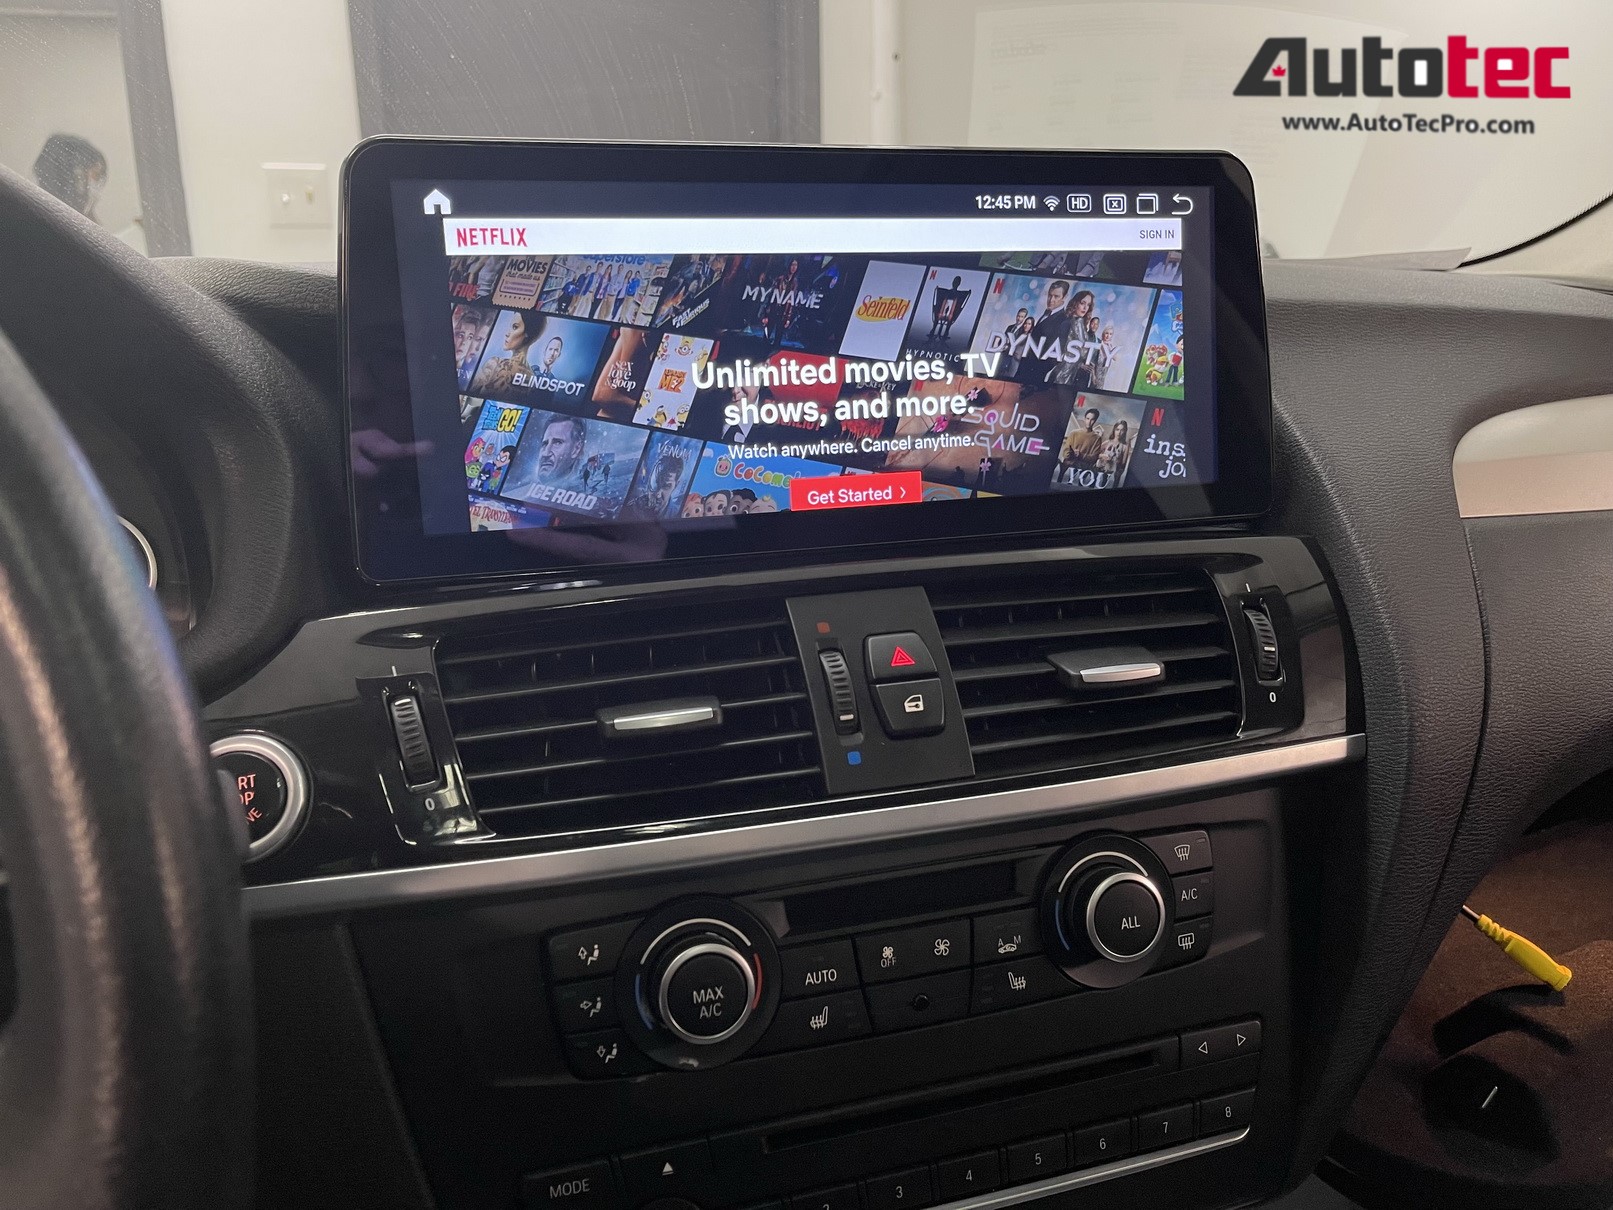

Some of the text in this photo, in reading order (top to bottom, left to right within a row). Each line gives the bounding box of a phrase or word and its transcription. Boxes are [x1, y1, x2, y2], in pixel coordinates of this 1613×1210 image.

[975, 195, 1035, 209] 12:45 PM
[1071, 197, 1088, 209] HD
[456, 227, 527, 247] NETFLIX
[1140, 229, 1175, 239] SIGN IN
[506, 258, 548, 274] MOVIES
[858, 295, 911, 321] Seinfeld
[905, 348, 961, 363] HYPNOTIC
[986, 331, 1123, 368] DYNASTY
[691, 352, 1001, 390] Unlimited movies, TV
[512, 373, 586, 396] BLINDSPOT
[724, 397, 828, 428] shows,
[835, 391, 890, 419] and
[896, 394, 976, 416] more.
[961, 403, 1040, 434] SQUID
[657, 439, 693, 461] VENOM
[728, 434, 975, 460] Watch anywhere. Cancel anytime.
[974, 430, 1050, 457] GAME
[1069, 467, 1111, 489] YOU
[525, 483, 555, 501] ICE
[551, 488, 598, 511] ROAD
[807, 486, 893, 505] Get Started
[1181, 887, 1198, 901] A/C
[1121, 916, 1141, 930] ALL
[880, 957, 897, 968] OFF
[805, 968, 837, 985] AUTO
[693, 986, 724, 1004] MAX
[700, 1002, 722, 1018] A/C
[1225, 1106, 1232, 1118] 8
[1162, 1121, 1170, 1133] 7
[1099, 1138, 1107, 1150] 6
[1034, 1153, 1042, 1165] 5
[965, 1170, 973, 1181] 4
[550, 1178, 590, 1199] MODE
[895, 1186, 903, 1199] 3
